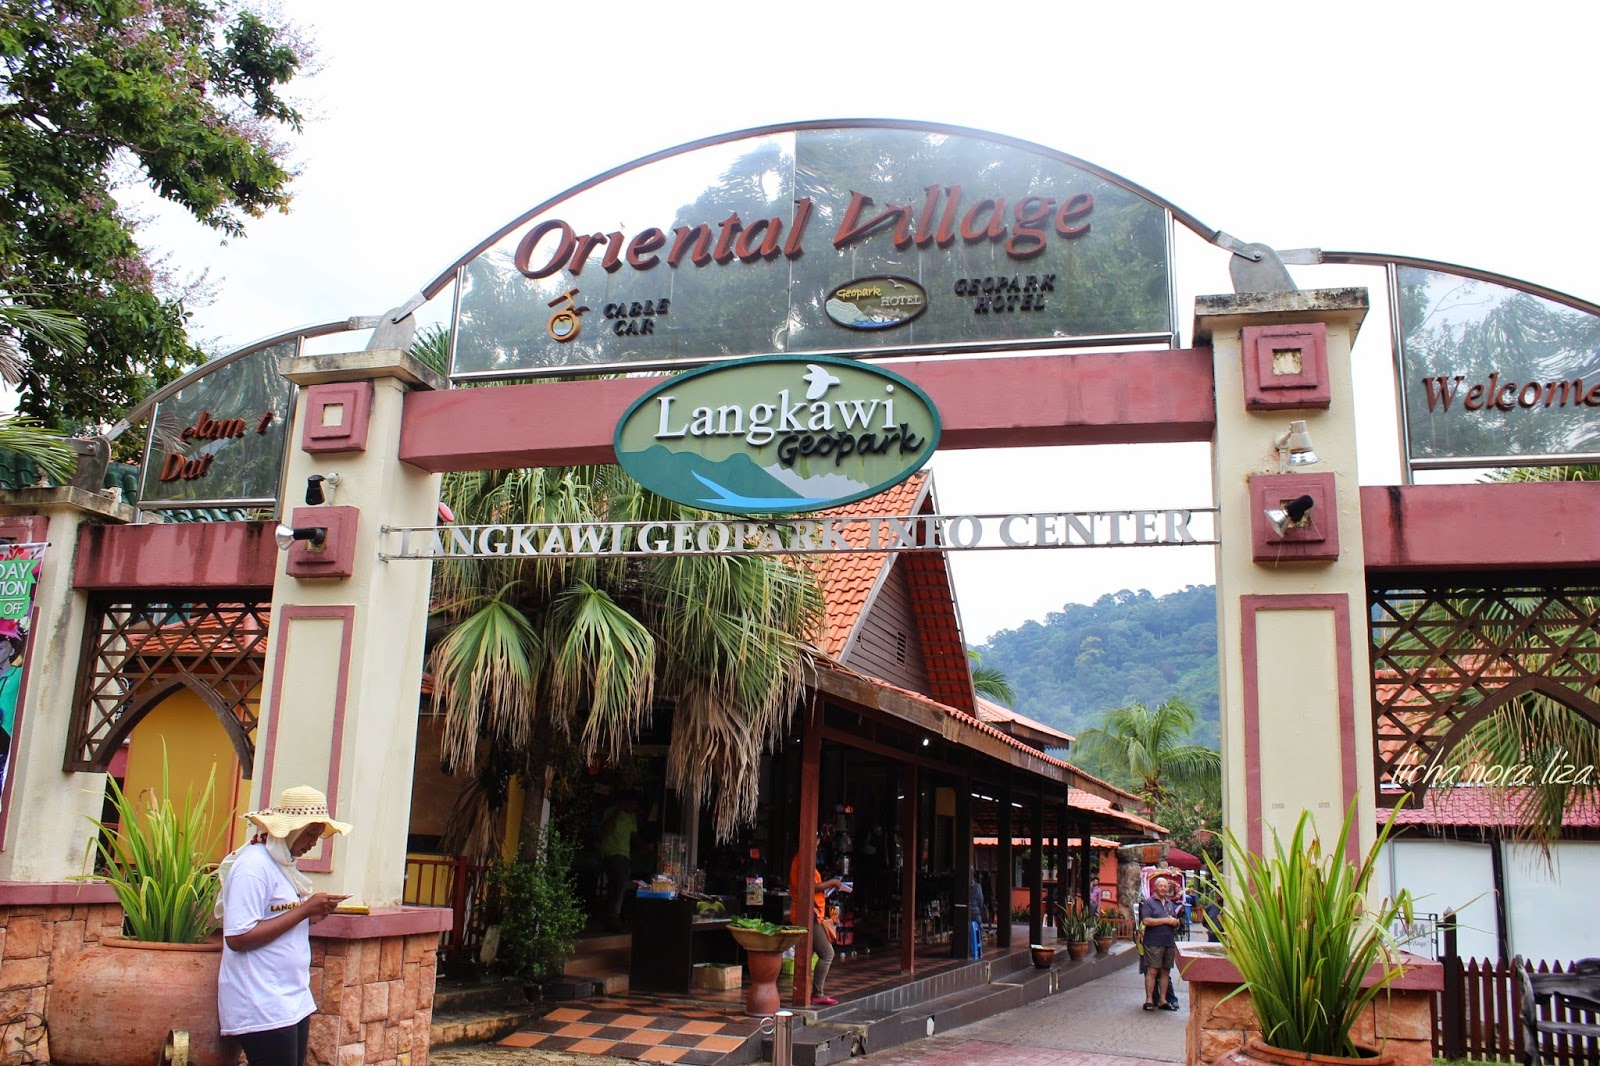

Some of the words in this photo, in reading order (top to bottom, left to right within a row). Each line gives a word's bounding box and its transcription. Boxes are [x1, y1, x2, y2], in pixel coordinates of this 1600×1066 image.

[514, 197, 814, 279] Oriental
[833, 184, 1094, 260] Village
[836, 286, 881, 300] Geopark
[954, 274, 1056, 297] GEOPARK
[603, 298, 671, 319] CABLE
[881, 295, 921, 306] HOTEL
[974, 294, 1045, 314] HOTEL
[613, 319, 655, 337] CAR
[1421, 371, 1600, 413] Welcome
[653, 384, 900, 446] Langkawi
[777, 422, 925, 466] Geopark
[159, 452, 214, 482] Dat
[400, 524, 625, 557] LANGKAWI
[637, 517, 852, 554] GEOPARK
[866, 515, 983, 550] INFO
[999, 508, 1196, 547] CENTER
[3, 602, 24, 615] OFF
